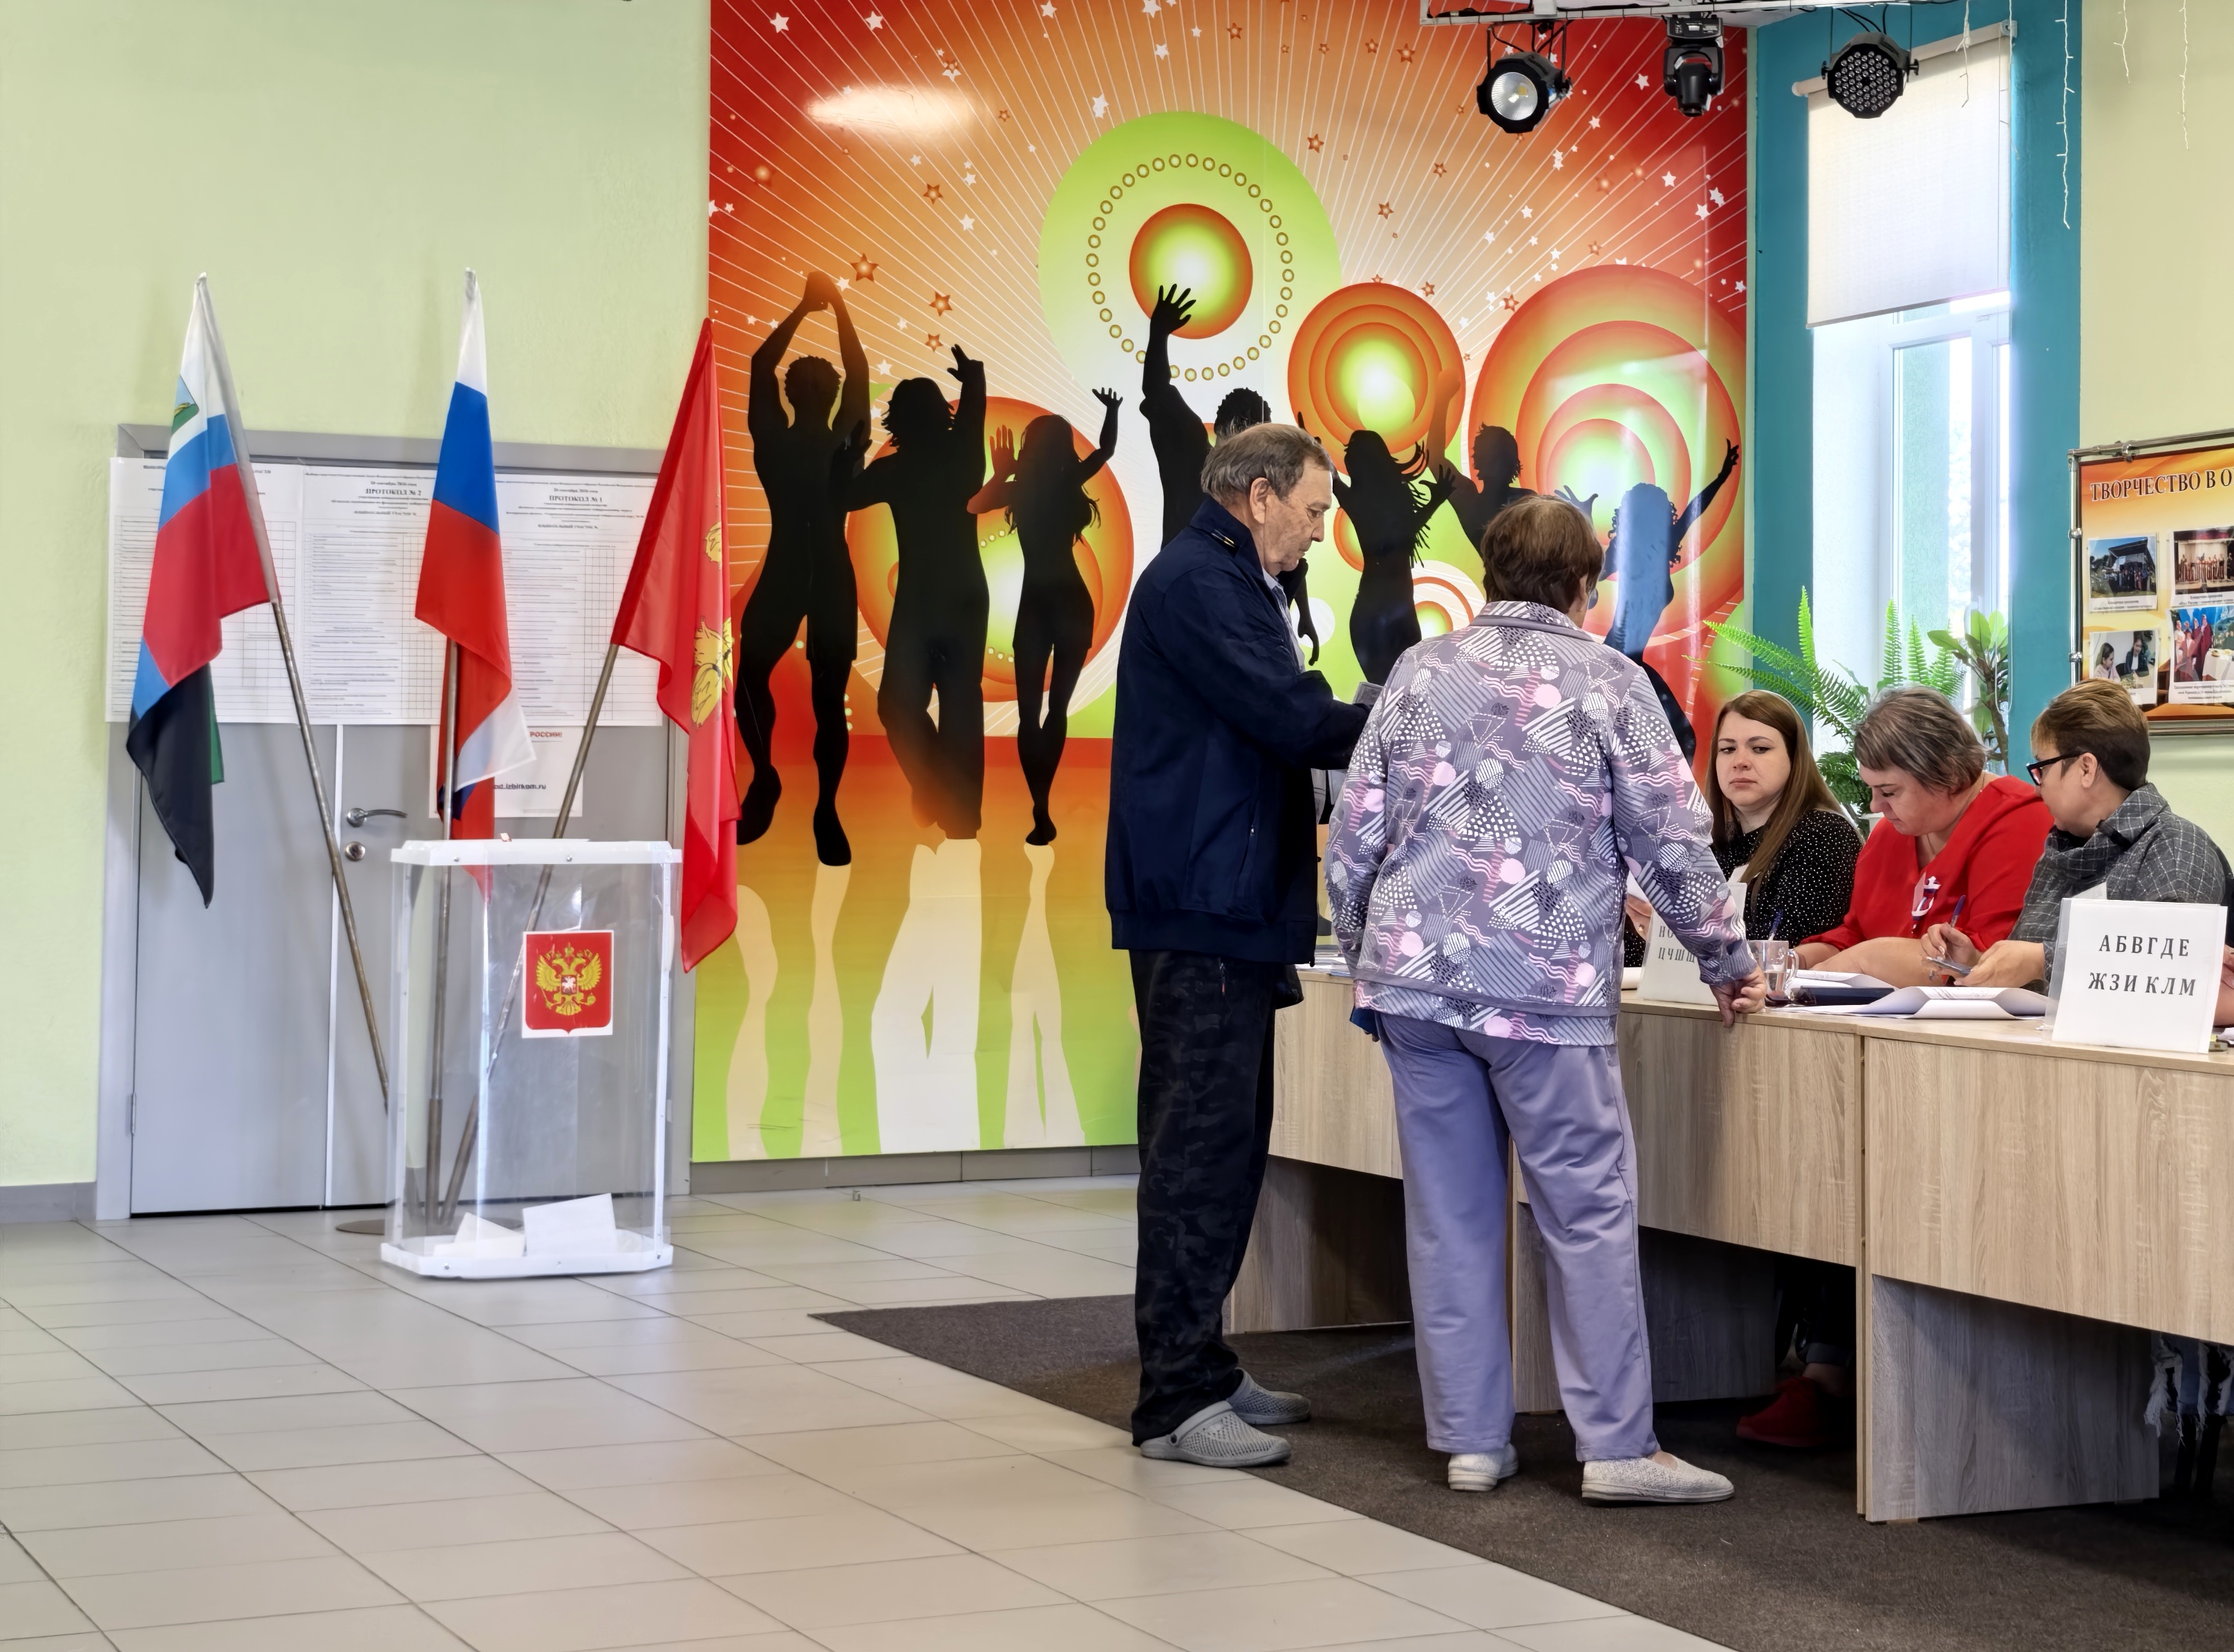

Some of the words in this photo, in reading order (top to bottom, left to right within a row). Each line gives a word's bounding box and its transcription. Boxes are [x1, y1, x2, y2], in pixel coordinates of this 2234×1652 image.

[2090, 472, 2201, 501] ТВОРЧЕСТВО
[2206, 470, 2216, 489] В
[2220, 467, 2234, 487] О
